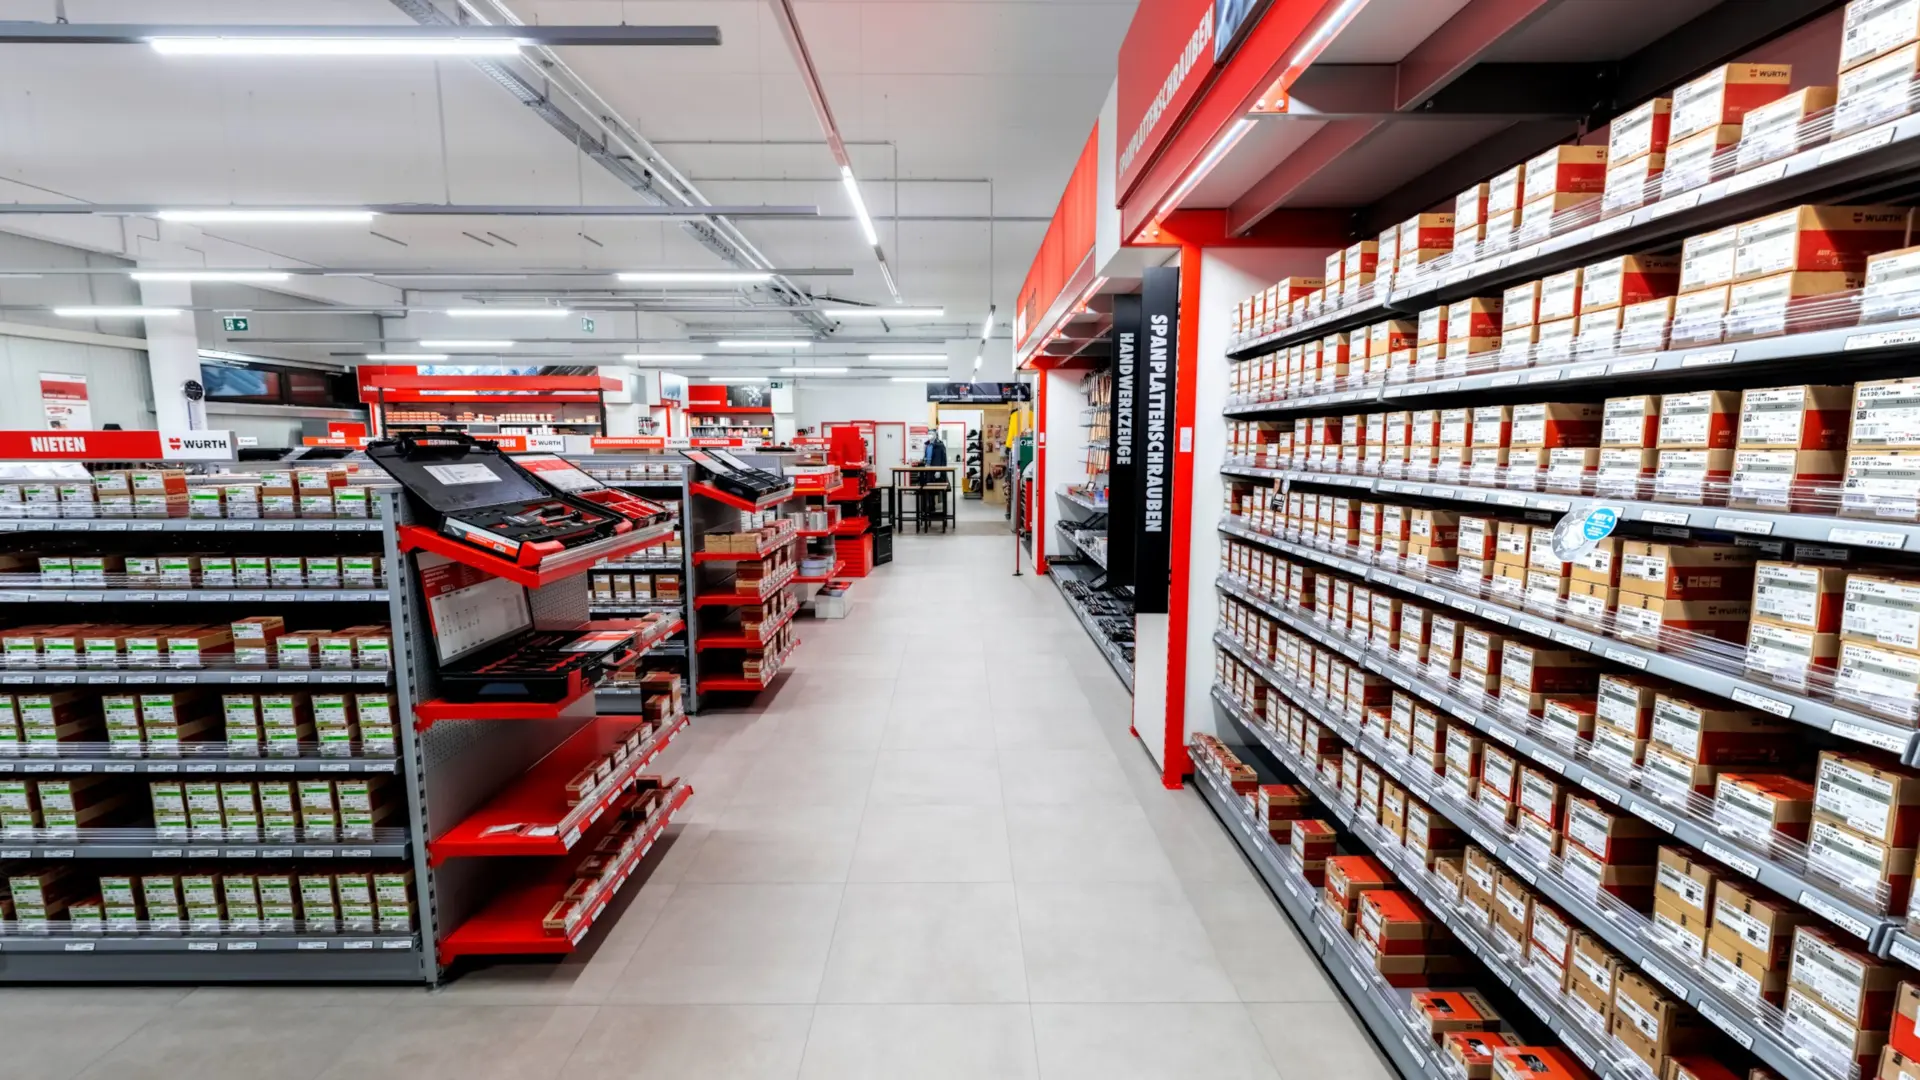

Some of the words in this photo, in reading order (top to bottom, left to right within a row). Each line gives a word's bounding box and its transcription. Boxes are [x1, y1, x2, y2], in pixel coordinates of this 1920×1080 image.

[1118, 5, 1213, 179] SPANPLATTENSCHRAUBEN
[1116, 332, 1135, 465] HANDWERKZEUGE
[1145, 314, 1168, 533] SPANPLATTENSCHRAUBEN
[1859, 390, 1901, 398] 5x120/62mm
[30, 436, 86, 453] NIETEN
[184, 440, 227, 449] WÜRTH
